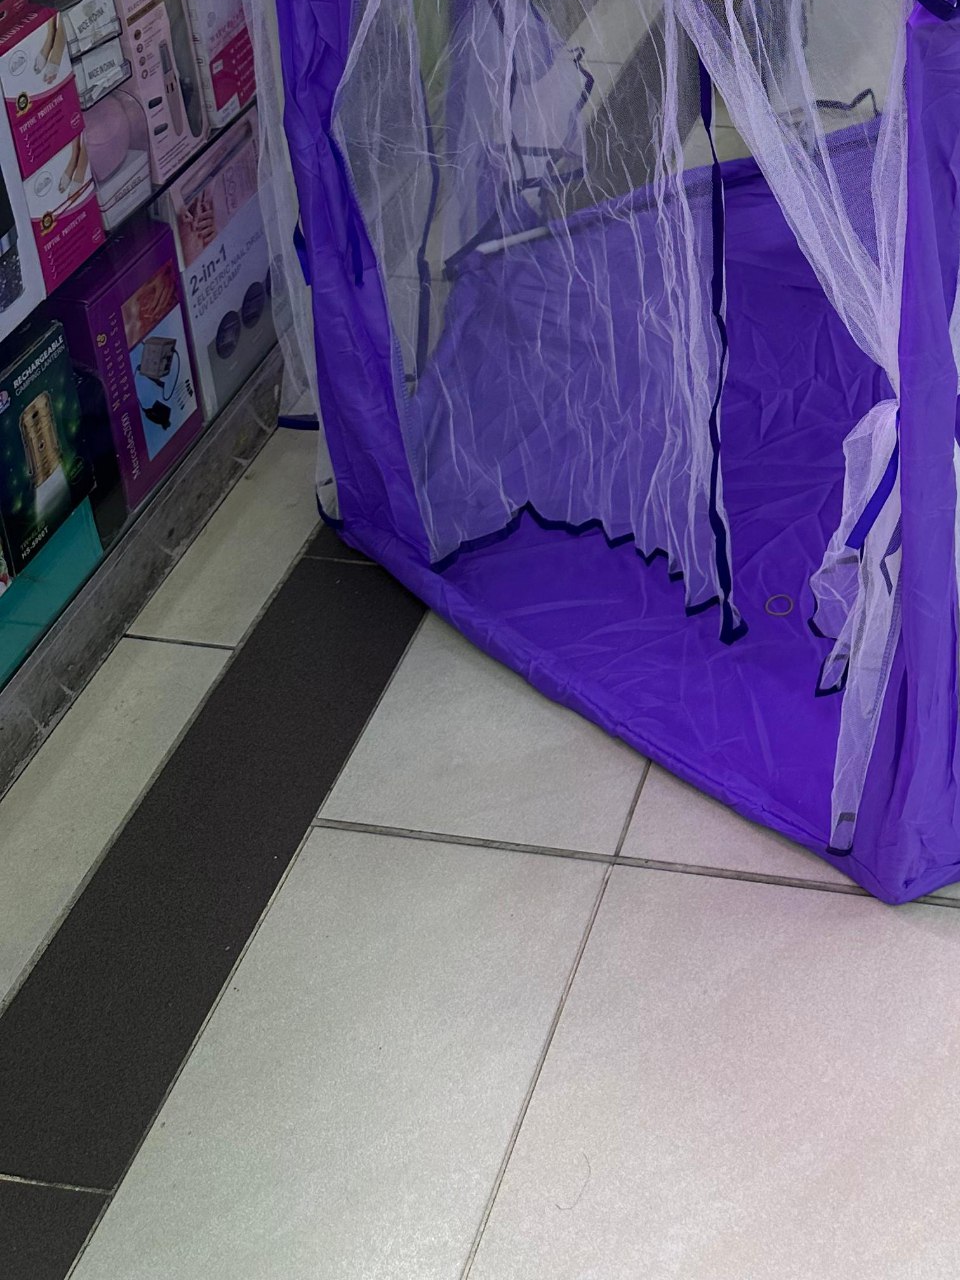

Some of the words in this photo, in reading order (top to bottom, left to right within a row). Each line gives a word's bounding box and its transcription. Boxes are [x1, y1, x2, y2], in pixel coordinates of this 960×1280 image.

[190, 243, 227, 296] 2-in-1
[196, 264, 231, 306] ELECTRIC
[198, 301, 209, 317] UV
[209, 284, 224, 305] LED
[223, 263, 242, 289] LAMP
[13, 334, 64, 389] RECHARGEABLE
[15, 367, 42, 397] CAMPING
[41, 344, 66, 374] LANTERN
